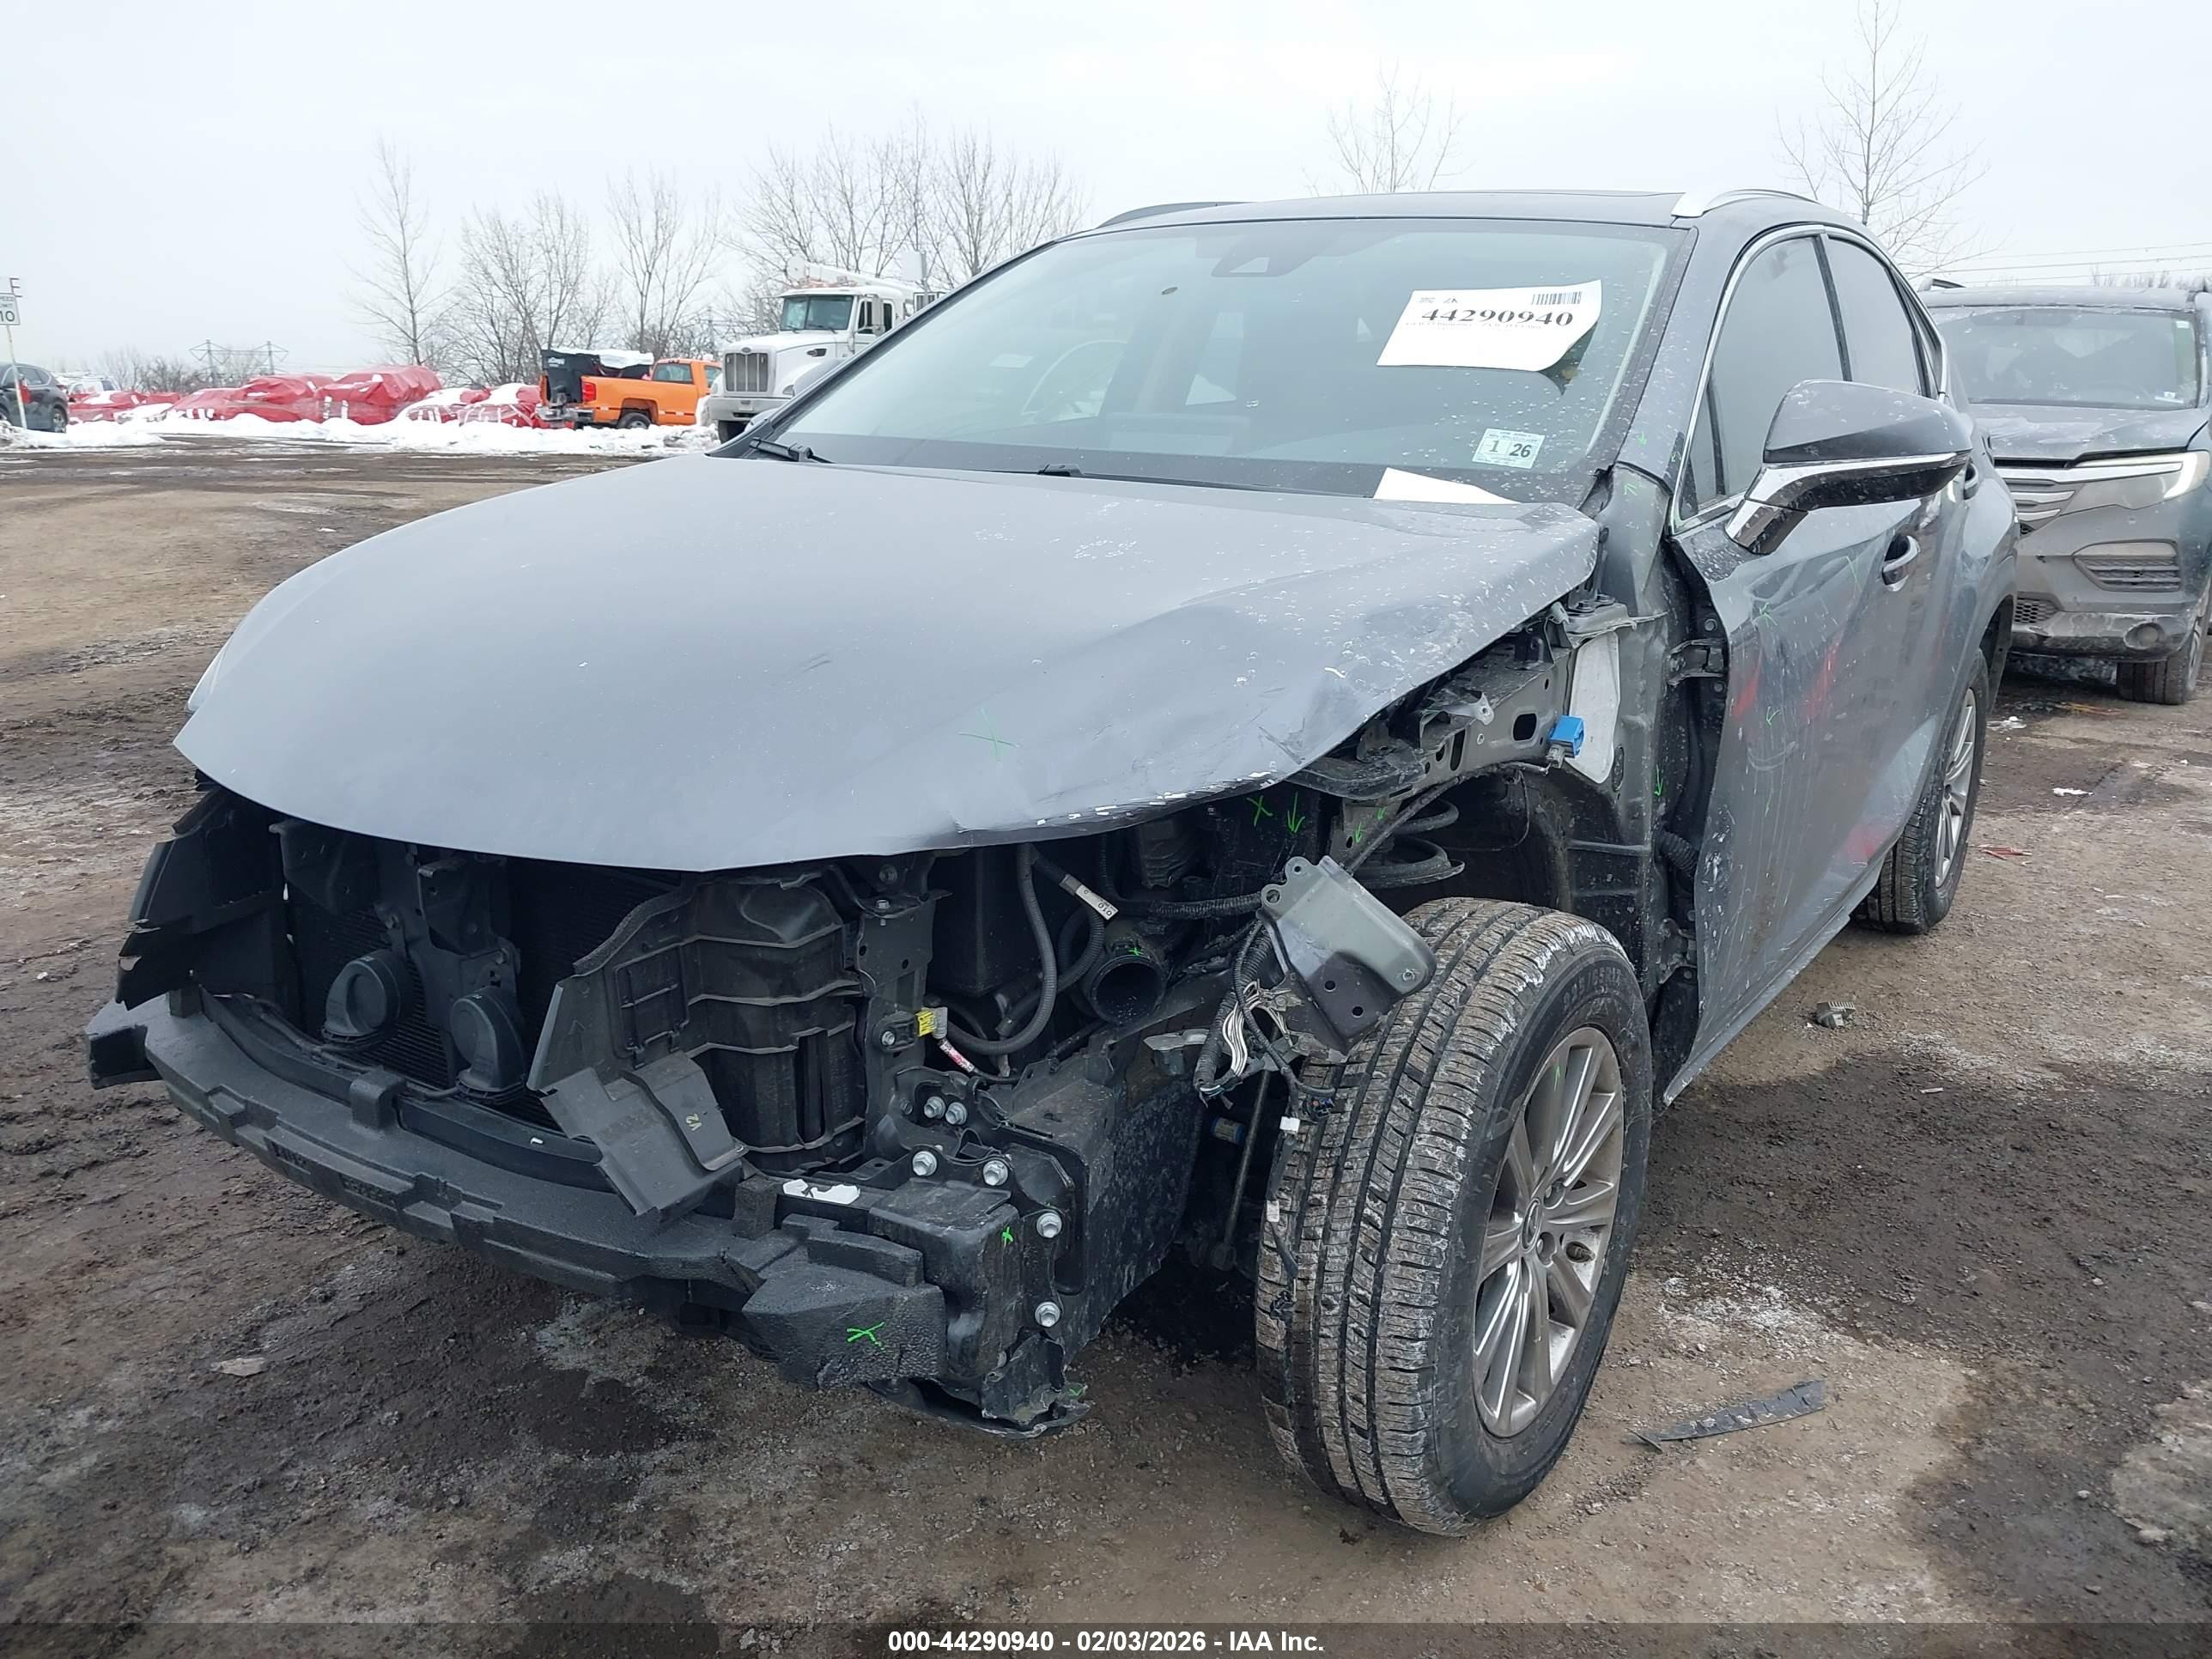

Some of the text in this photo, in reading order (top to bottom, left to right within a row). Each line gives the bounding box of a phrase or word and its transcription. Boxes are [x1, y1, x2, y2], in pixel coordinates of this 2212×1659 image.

[0, 310, 15, 322] 10
[1421, 308, 1573, 327] 44290940
[1488, 440, 1500, 453] 1
[1509, 442, 1532, 458] 26
